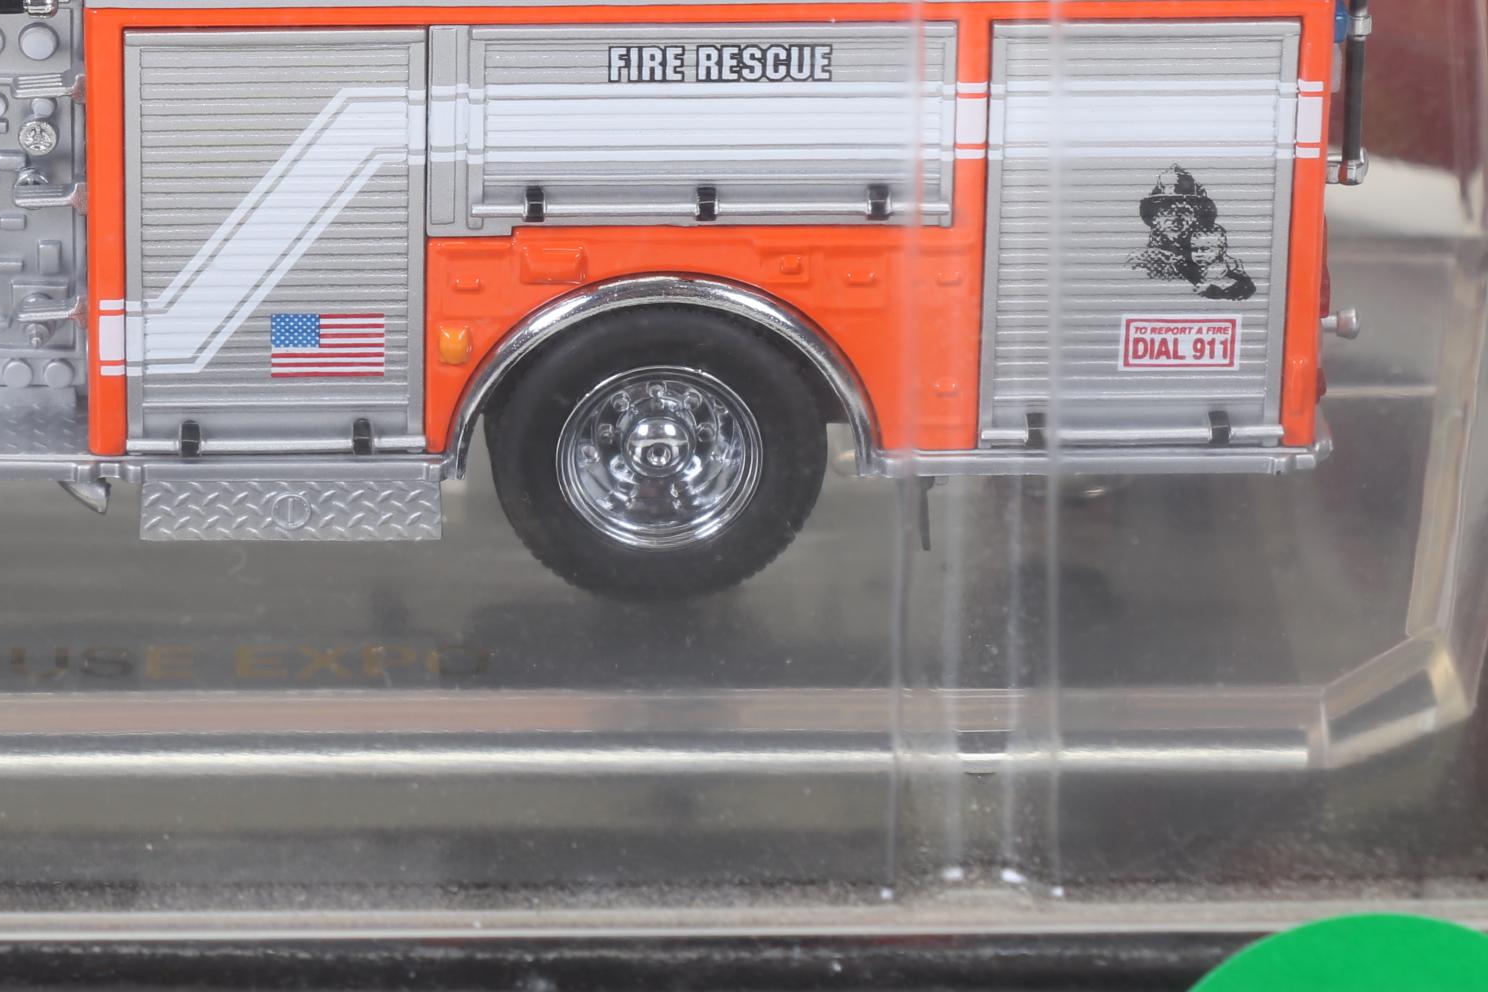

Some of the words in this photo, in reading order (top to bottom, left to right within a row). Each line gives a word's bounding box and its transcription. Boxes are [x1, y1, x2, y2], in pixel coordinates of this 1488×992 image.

[609, 45, 685, 82] FIRE
[695, 44, 833, 83] RESCUE
[1133, 326, 1148, 335] TO
[1150, 326, 1194, 335] REPORT
[1195, 326, 1204, 335] A
[1206, 326, 1231, 335] FIRE
[1132, 337, 1186, 360] DIAL
[1192, 337, 1229, 360] 911
